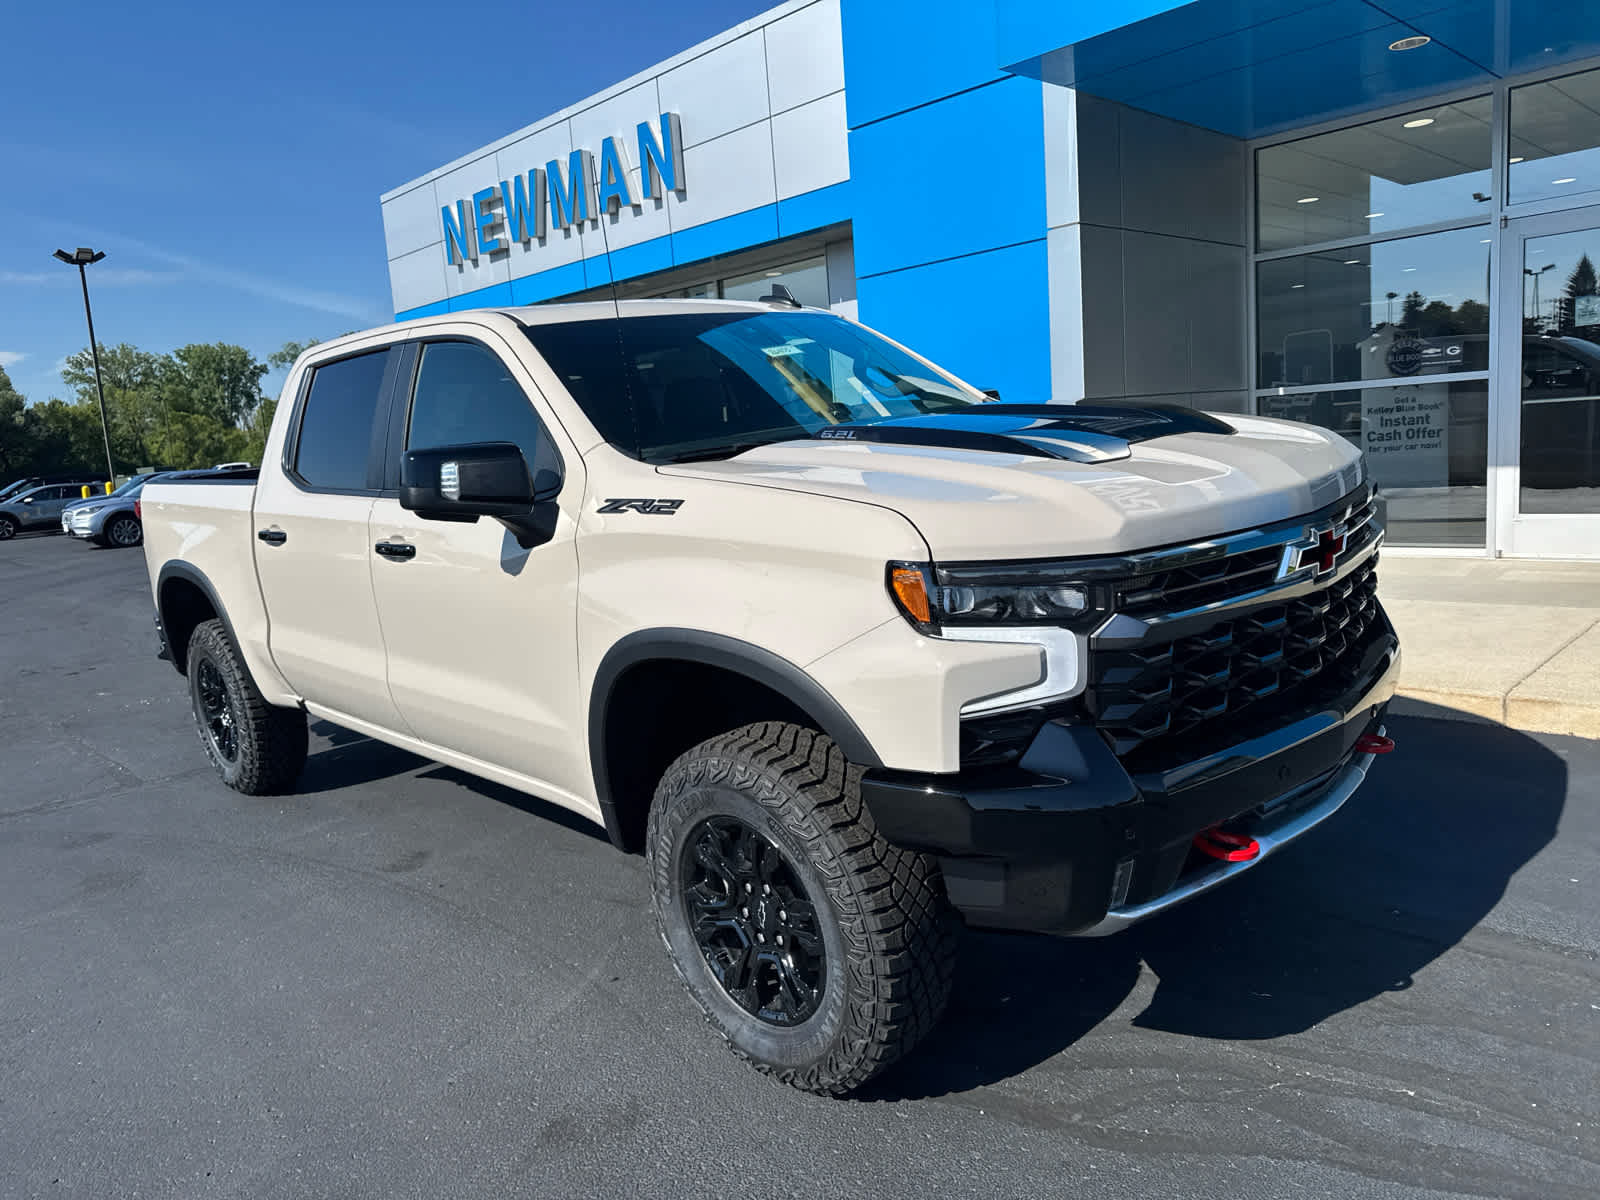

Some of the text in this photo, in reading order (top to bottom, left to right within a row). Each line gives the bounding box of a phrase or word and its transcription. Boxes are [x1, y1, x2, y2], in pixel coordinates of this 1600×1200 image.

[441, 111, 685, 266] NEWMAN
[1367, 406, 1394, 415] Kelley
[1396, 404, 1415, 412] Blue
[1380, 413, 1431, 428] Instant
[1367, 426, 1444, 442] Cash Offer
[1383, 445, 1402, 453] your
[596, 498, 686, 516] ZR2
